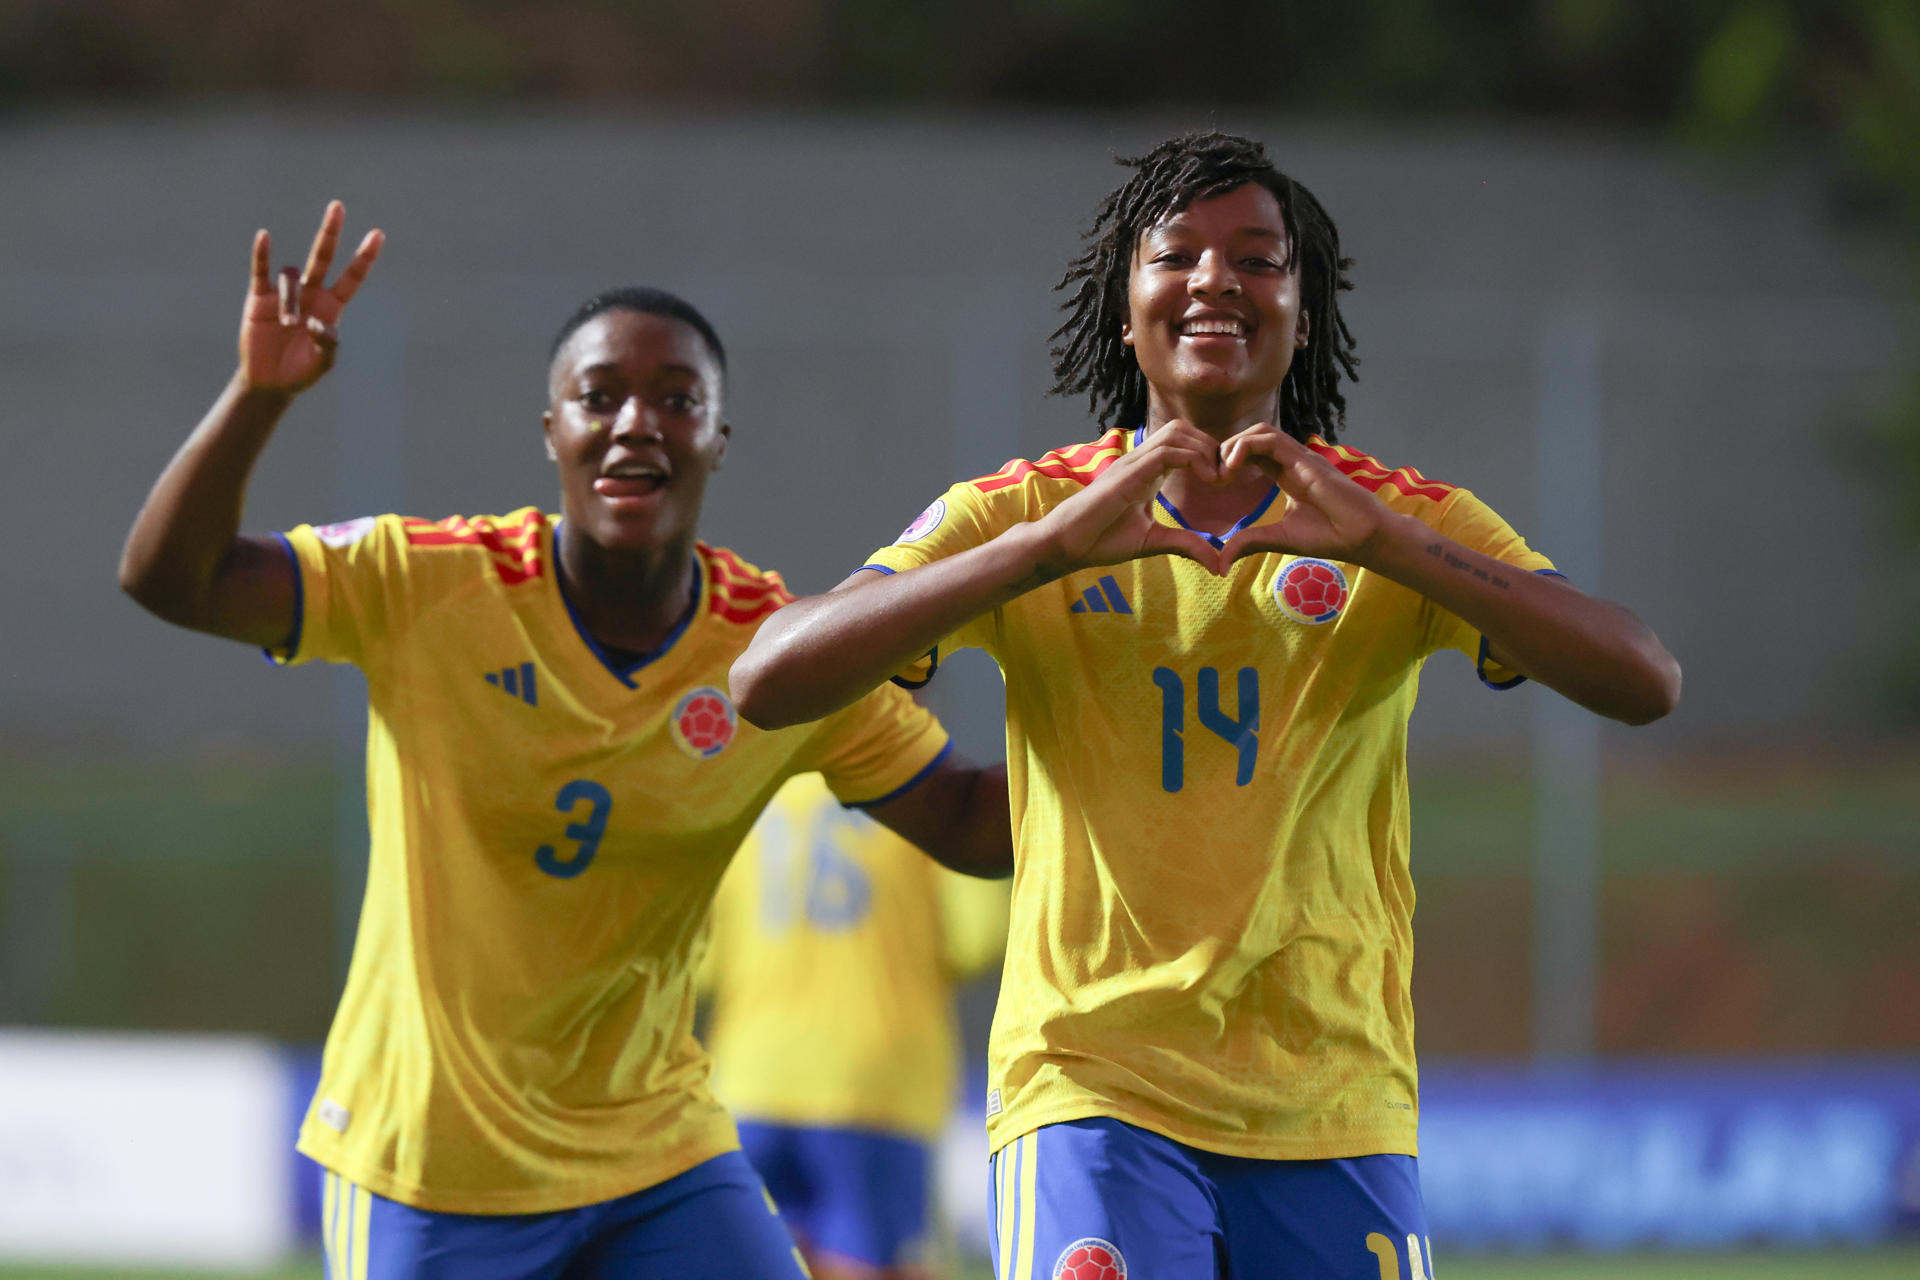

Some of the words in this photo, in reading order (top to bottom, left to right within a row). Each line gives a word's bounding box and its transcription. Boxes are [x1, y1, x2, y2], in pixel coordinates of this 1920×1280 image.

[1153, 666, 1259, 793] 14
[534, 779, 613, 878] 3
[758, 799, 873, 932] 16
